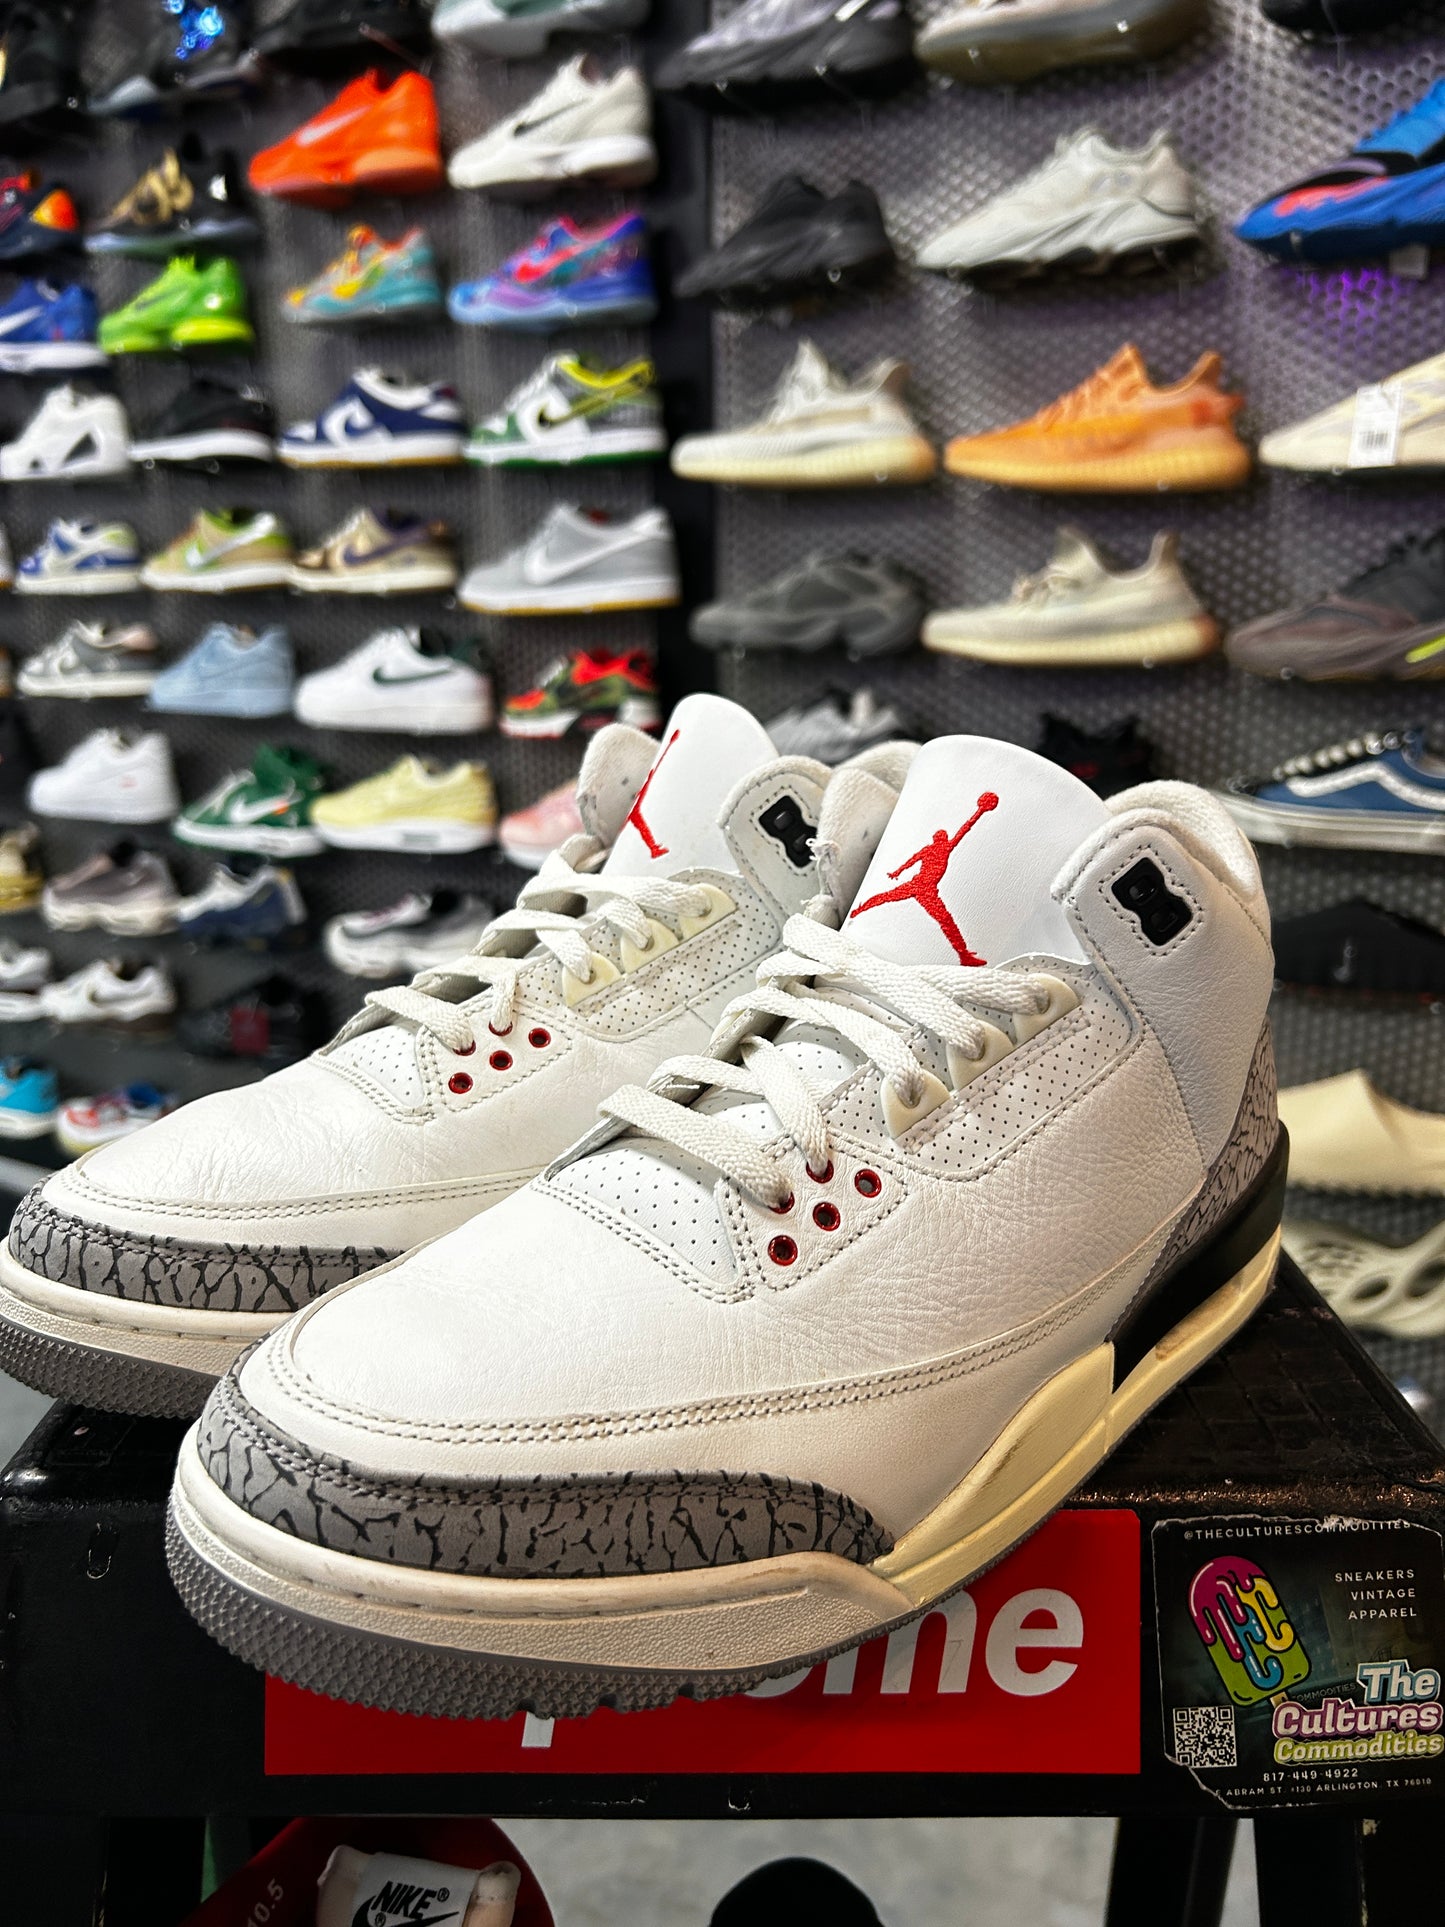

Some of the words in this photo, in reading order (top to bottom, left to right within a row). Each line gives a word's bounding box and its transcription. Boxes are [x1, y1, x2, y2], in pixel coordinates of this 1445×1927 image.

[1334, 1568, 1415, 1583] SNEAKERS
[1350, 1587, 1416, 1601] VINTAGE
[1348, 1606, 1418, 1620] APPAREL
[1360, 1662, 1438, 1701] The
[1274, 1699, 1441, 1737] Cultures
[1275, 1731, 1443, 1763] Commodities
[1262, 1768, 1359, 1782] 817-449-4922
[1226, 1787, 1265, 1796] ABRAM
[1386, 1779, 1399, 1787] TX
